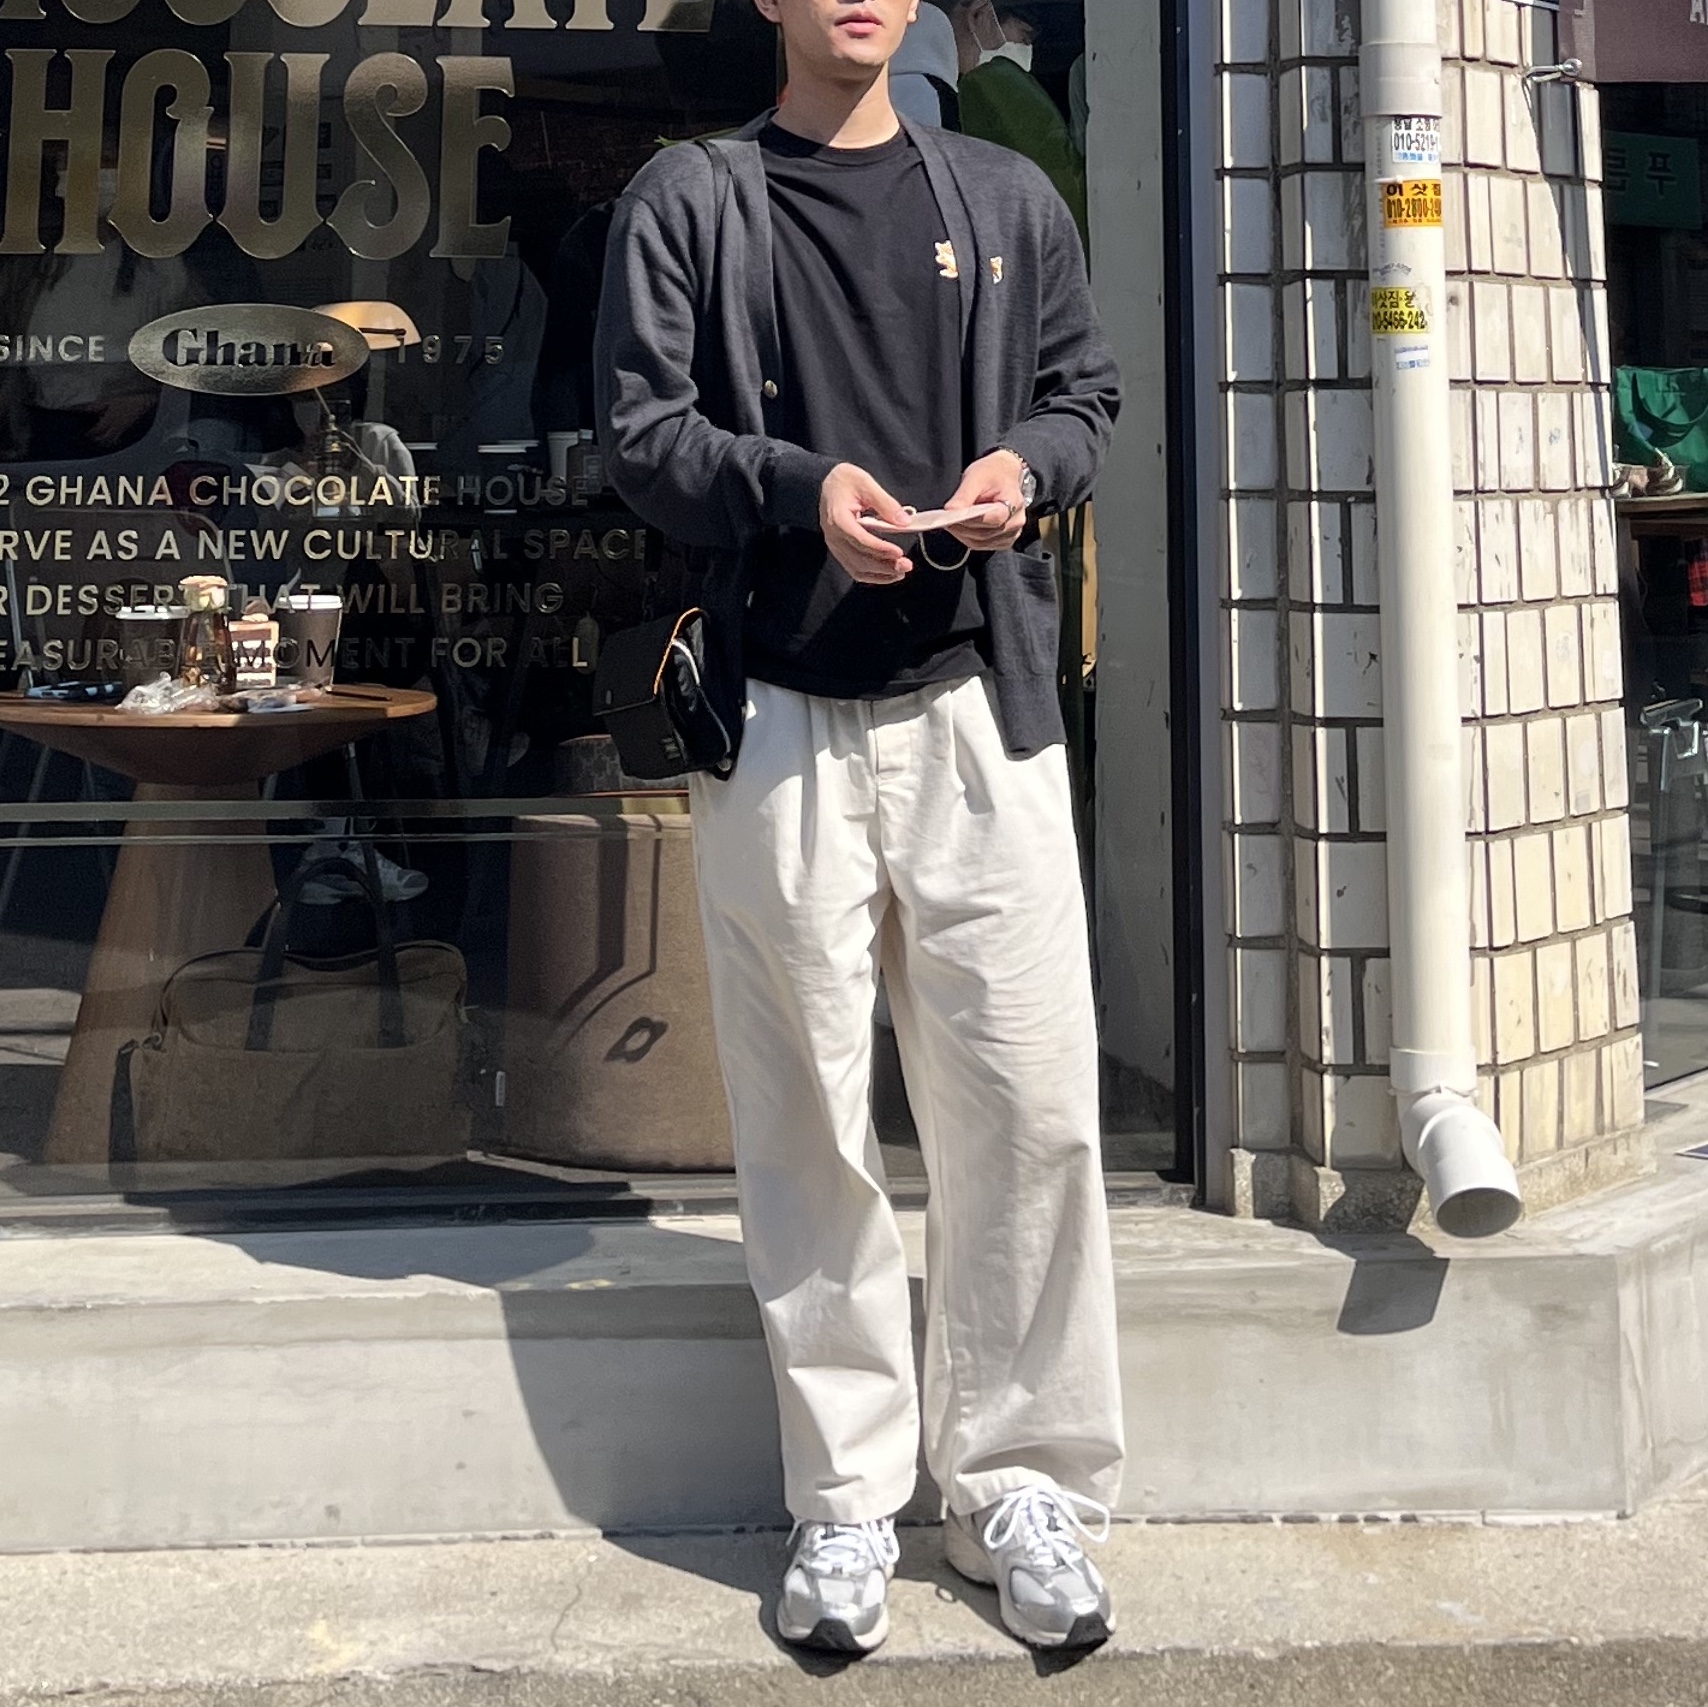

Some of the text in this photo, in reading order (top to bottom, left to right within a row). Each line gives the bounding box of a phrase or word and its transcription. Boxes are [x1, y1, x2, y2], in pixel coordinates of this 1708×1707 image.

[0, 48, 515, 259] HOUSE
[0, 328, 505, 368] SINCE Ghana 1975
[26, 475, 174, 506] GHANA
[189, 474, 440, 506] CHOCOLATE
[457, 474, 589, 506] HOUSE
[86, 529, 139, 561] AS
[154, 529, 181, 560] A
[197, 529, 290, 560] NEW
[303, 528, 508, 561] CULTURAL
[523, 528, 647, 561] SPACE
[337, 583, 425, 614] WILL
[441, 582, 564, 614] BRING
[235, 637, 415, 669] MOMENT
[431, 636, 507, 669] FOR
[521, 636, 588, 668] ALL
